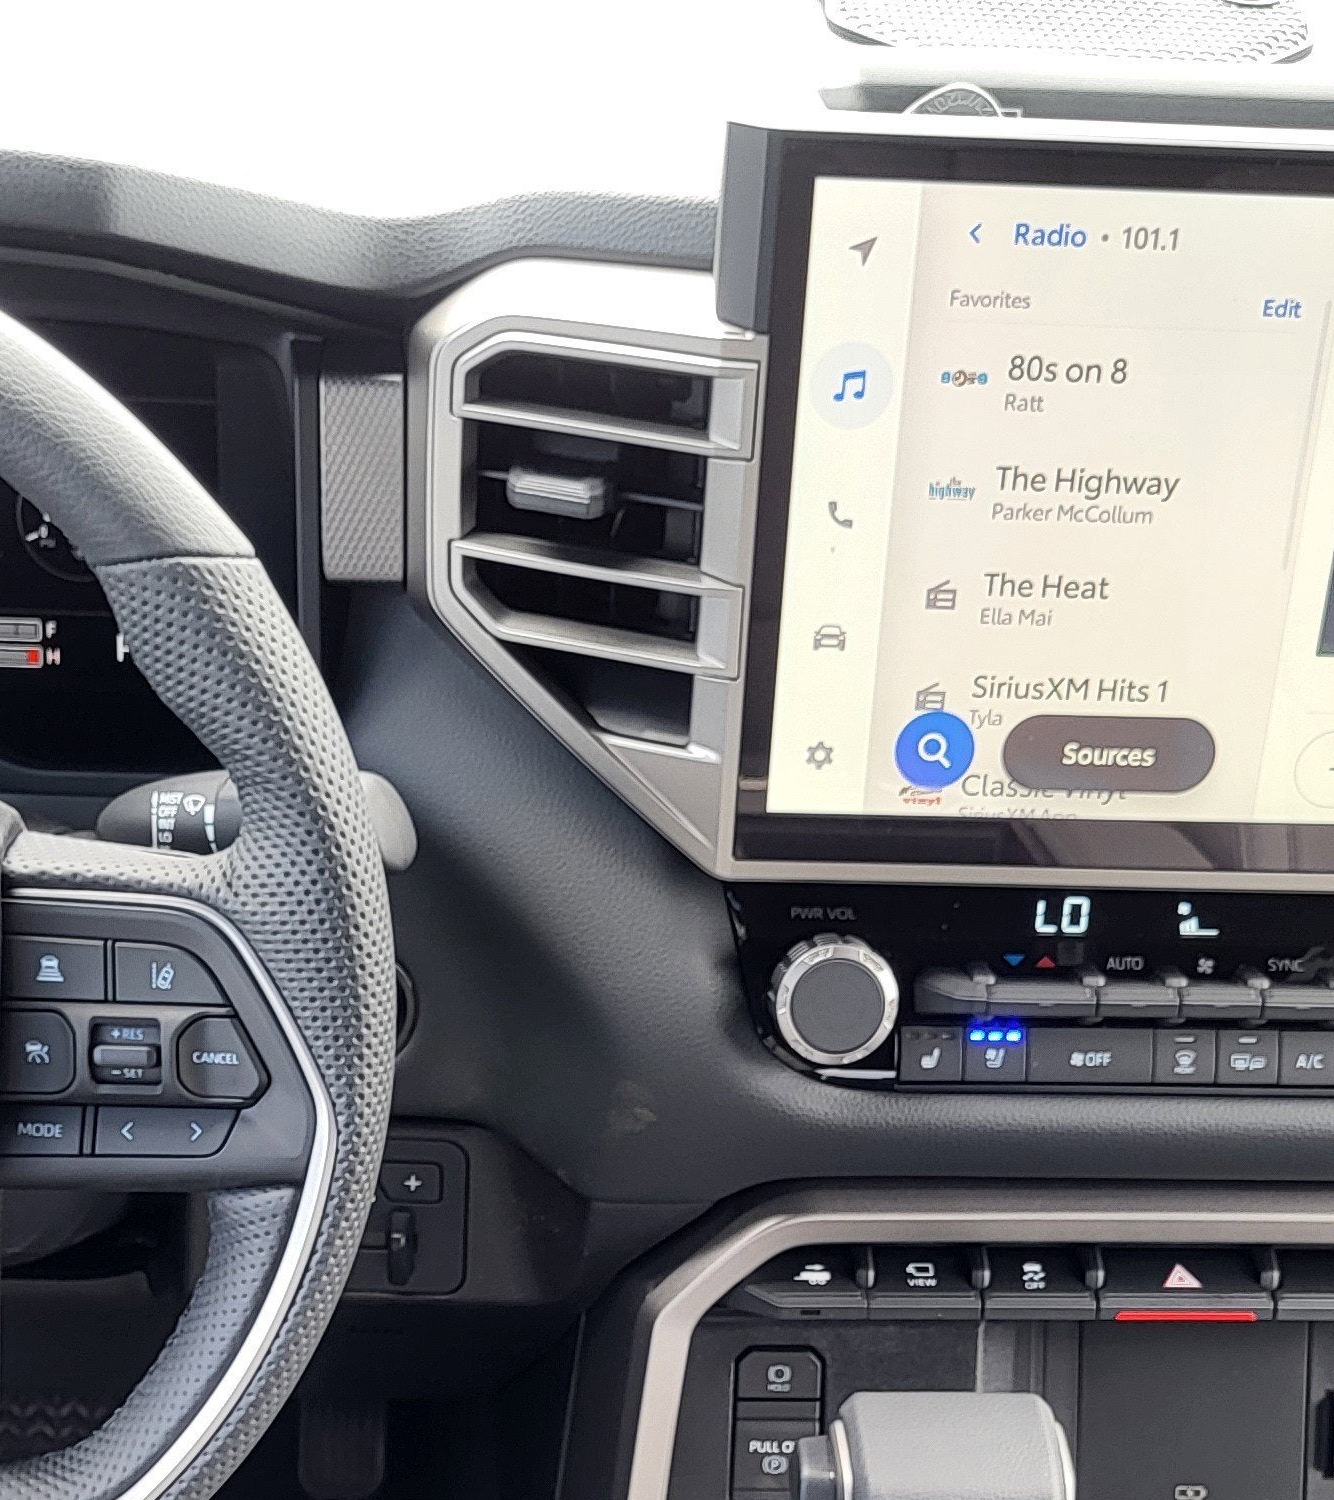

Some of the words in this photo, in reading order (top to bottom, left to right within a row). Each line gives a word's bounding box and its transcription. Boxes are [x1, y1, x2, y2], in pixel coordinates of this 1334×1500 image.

[1014, 223, 1087, 249] Radio
[1122, 226, 1179, 251] 101.1
[949, 289, 1031, 310] Favorites
[1262, 298, 1302, 319] Edit
[1008, 356, 1058, 384] 80s
[1065, 363, 1102, 384] on
[1110, 358, 1129, 385] 8
[1005, 394, 1044, 413] Ratt
[996, 467, 1046, 493] The
[1055, 468, 1180, 503] Highway
[992, 504, 1053, 523] Parker
[1057, 506, 1154, 525] McCollum
[984, 573, 1036, 599] The
[1042, 575, 1110, 601] Heat
[980, 608, 1013, 627] Ella
[1019, 609, 1053, 627] Mai
[45, 620, 58, 639] F
[45, 647, 61, 666] H
[971, 675, 1090, 701] SiriusXM
[1098, 679, 1150, 702] Hits
[1157, 680, 1169, 702] 1
[969, 709, 1003, 729] Tyla
[1061, 743, 1157, 768] Sources
[791, 906, 823, 921] PWR
[826, 906, 857, 921] VOL
[1034, 896, 1091, 935] LO
[1106, 955, 1145, 972] AUTO
[1268, 957, 1305, 973] SYNC
[192, 1050, 240, 1066] CANCEL
[1085, 1052, 1113, 1068] OFF
[1294, 1053, 1325, 1070] A/C
[17, 1121, 64, 1139] MODE
[906, 1278, 938, 1288] VIEW
[749, 1440, 780, 1454] PULL
